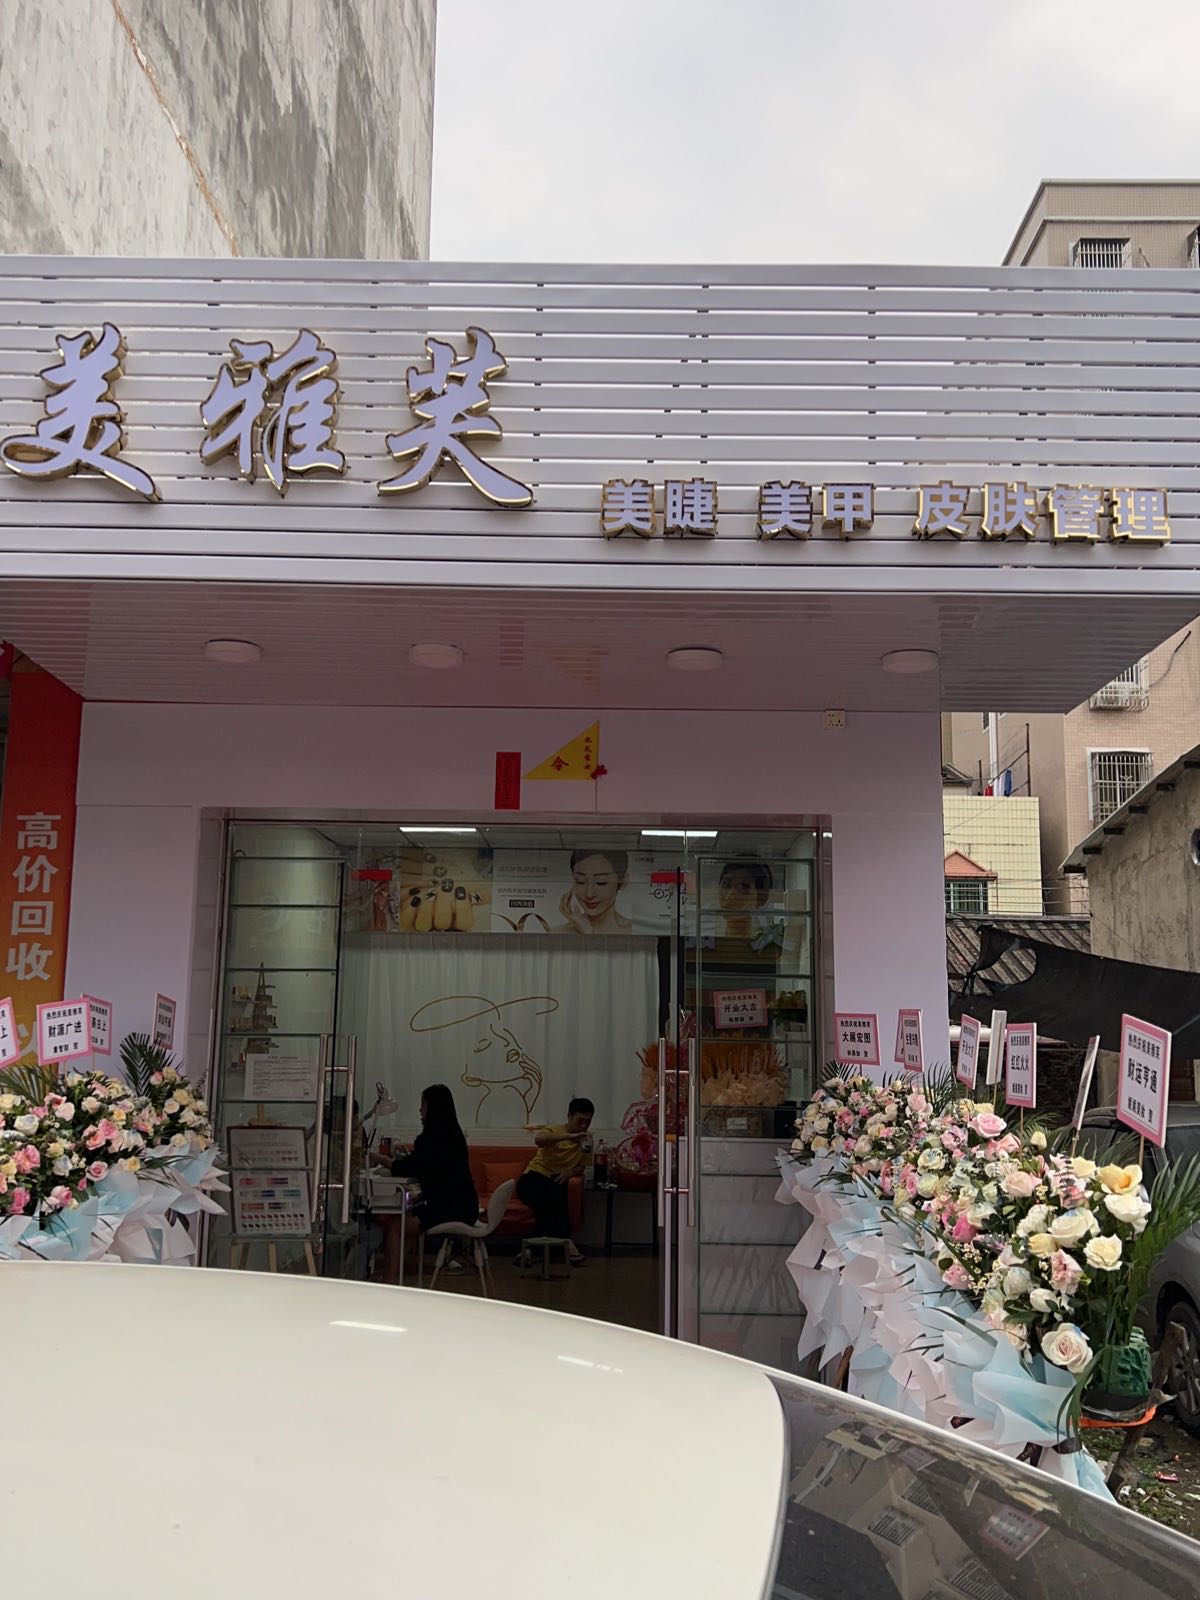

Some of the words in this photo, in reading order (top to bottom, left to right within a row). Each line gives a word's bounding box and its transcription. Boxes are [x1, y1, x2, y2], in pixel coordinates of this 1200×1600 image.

[1, 322, 536, 507] 美雅芙
[600, 477, 719, 540] 美睫
[757, 480, 877, 542] 美甲
[913, 479, 1173, 546] 皮肤管理
[6, 812, 62, 981] 高价回收
[723, 1003, 757, 1013] 开业大吉
[48, 1021, 82, 1038] 财源广进
[842, 1031, 871, 1043] 大展宏图
[1128, 1058, 1158, 1094] 财运亨通
